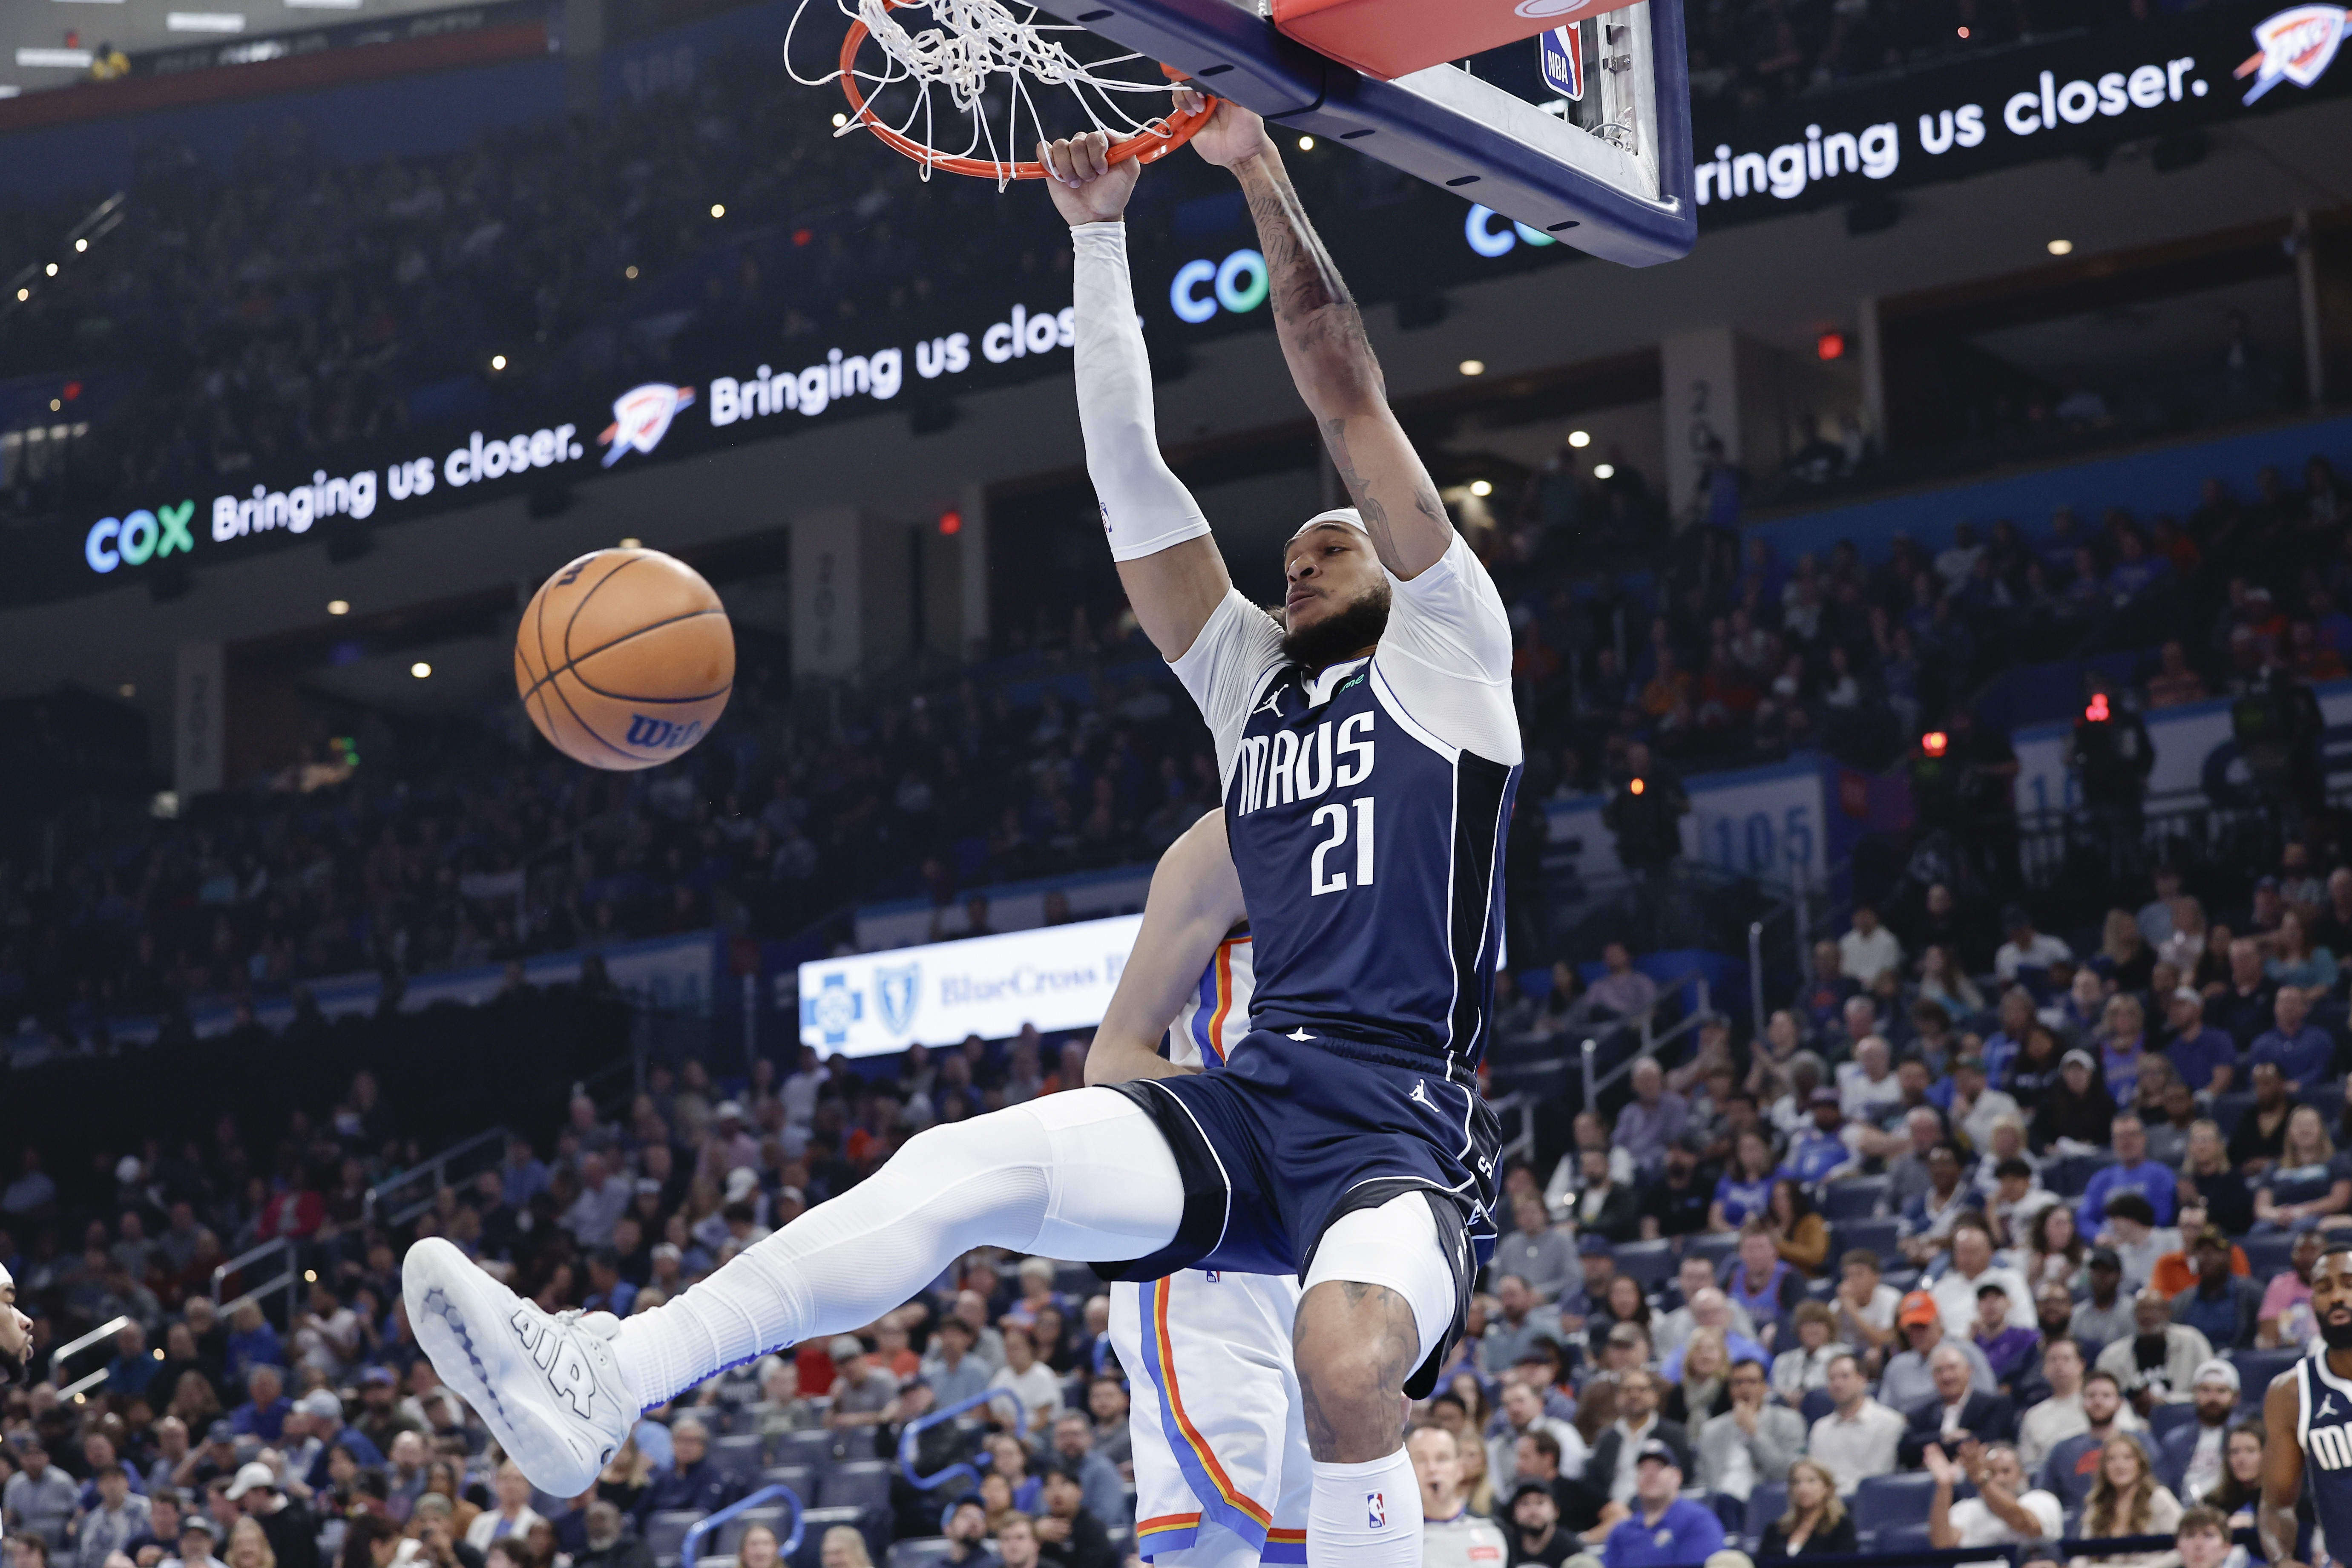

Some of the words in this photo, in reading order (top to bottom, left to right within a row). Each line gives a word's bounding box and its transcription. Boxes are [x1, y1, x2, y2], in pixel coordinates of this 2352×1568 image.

[1547, 49, 1569, 85] NBA
[1694, 122, 1900, 206] ringing
[1918, 104, 1986, 155] us
[2004, 57, 2209, 136] closer.
[1170, 249, 1269, 323] CO
[710, 347, 903, 427] Bringing
[915, 332, 971, 379] us
[982, 294, 1075, 363] clos
[85, 500, 195, 573] COX
[212, 469, 377, 542] Bringing
[387, 457, 435, 501] us
[444, 423, 584, 487] closer.
[1238, 710, 1375, 817] MAVS
[1311, 796, 1375, 897] 21
[511, 1309, 595, 1419] AIR
